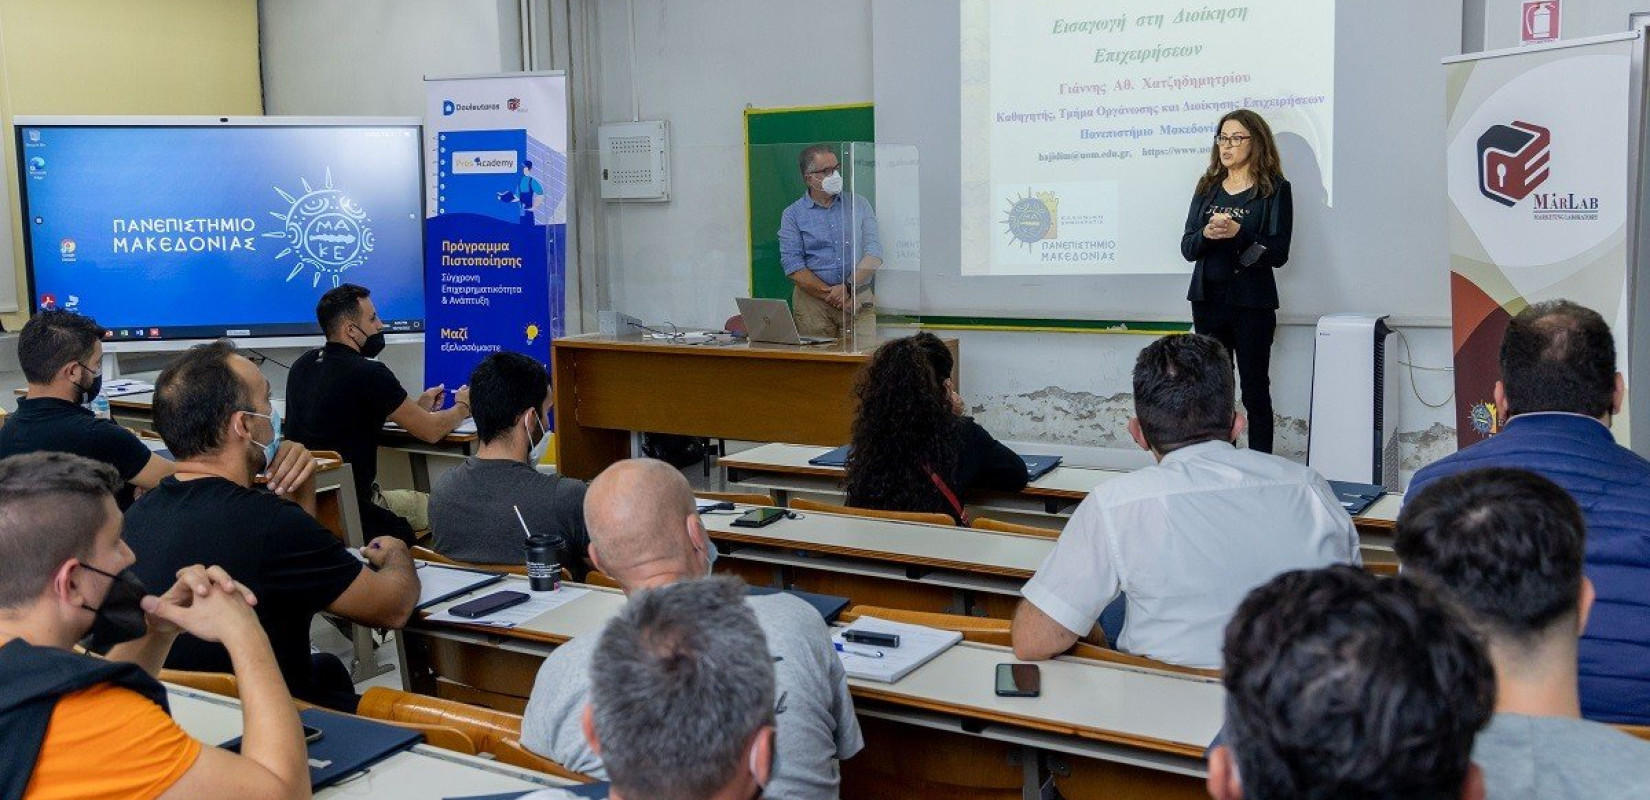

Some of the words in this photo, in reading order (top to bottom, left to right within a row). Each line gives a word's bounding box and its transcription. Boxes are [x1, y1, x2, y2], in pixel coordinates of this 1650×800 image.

[1051, 13, 1127, 35] Εισαγωγή
[1135, 13, 1164, 29] στη
[1172, 6, 1249, 25] Διοίκηση
[1093, 42, 1204, 66] Επιχειρήσεων
[1058, 81, 1107, 96] Γιάννης
[1142, 71, 1251, 91] Χατζηδημητρίου
[1058, 106, 1094, 121] Τμήμα
[1161, 102, 1180, 113] και
[1080, 126, 1154, 140] Πανεπιστήμιο
[113, 218, 256, 233] ΠΑΝΕΠΙΣΤΗΜΙΟ
[113, 236, 257, 253] ΜΑΚΕΔΟΝΙΑΣ
[442, 238, 510, 253] Πρόγραμμα
[1041, 240, 1116, 250] ΠΑΝΕΠΙΣΤΗΜΙΟ
[441, 254, 522, 268] Πιστοποίησης
[1041, 252, 1116, 262] ΜΑΚΕΔΟΝΙΑΣ
[440, 273, 481, 284] Σύγχρονη
[449, 296, 489, 306] Ανάπτυξη
[440, 326, 468, 340] Μαζί
